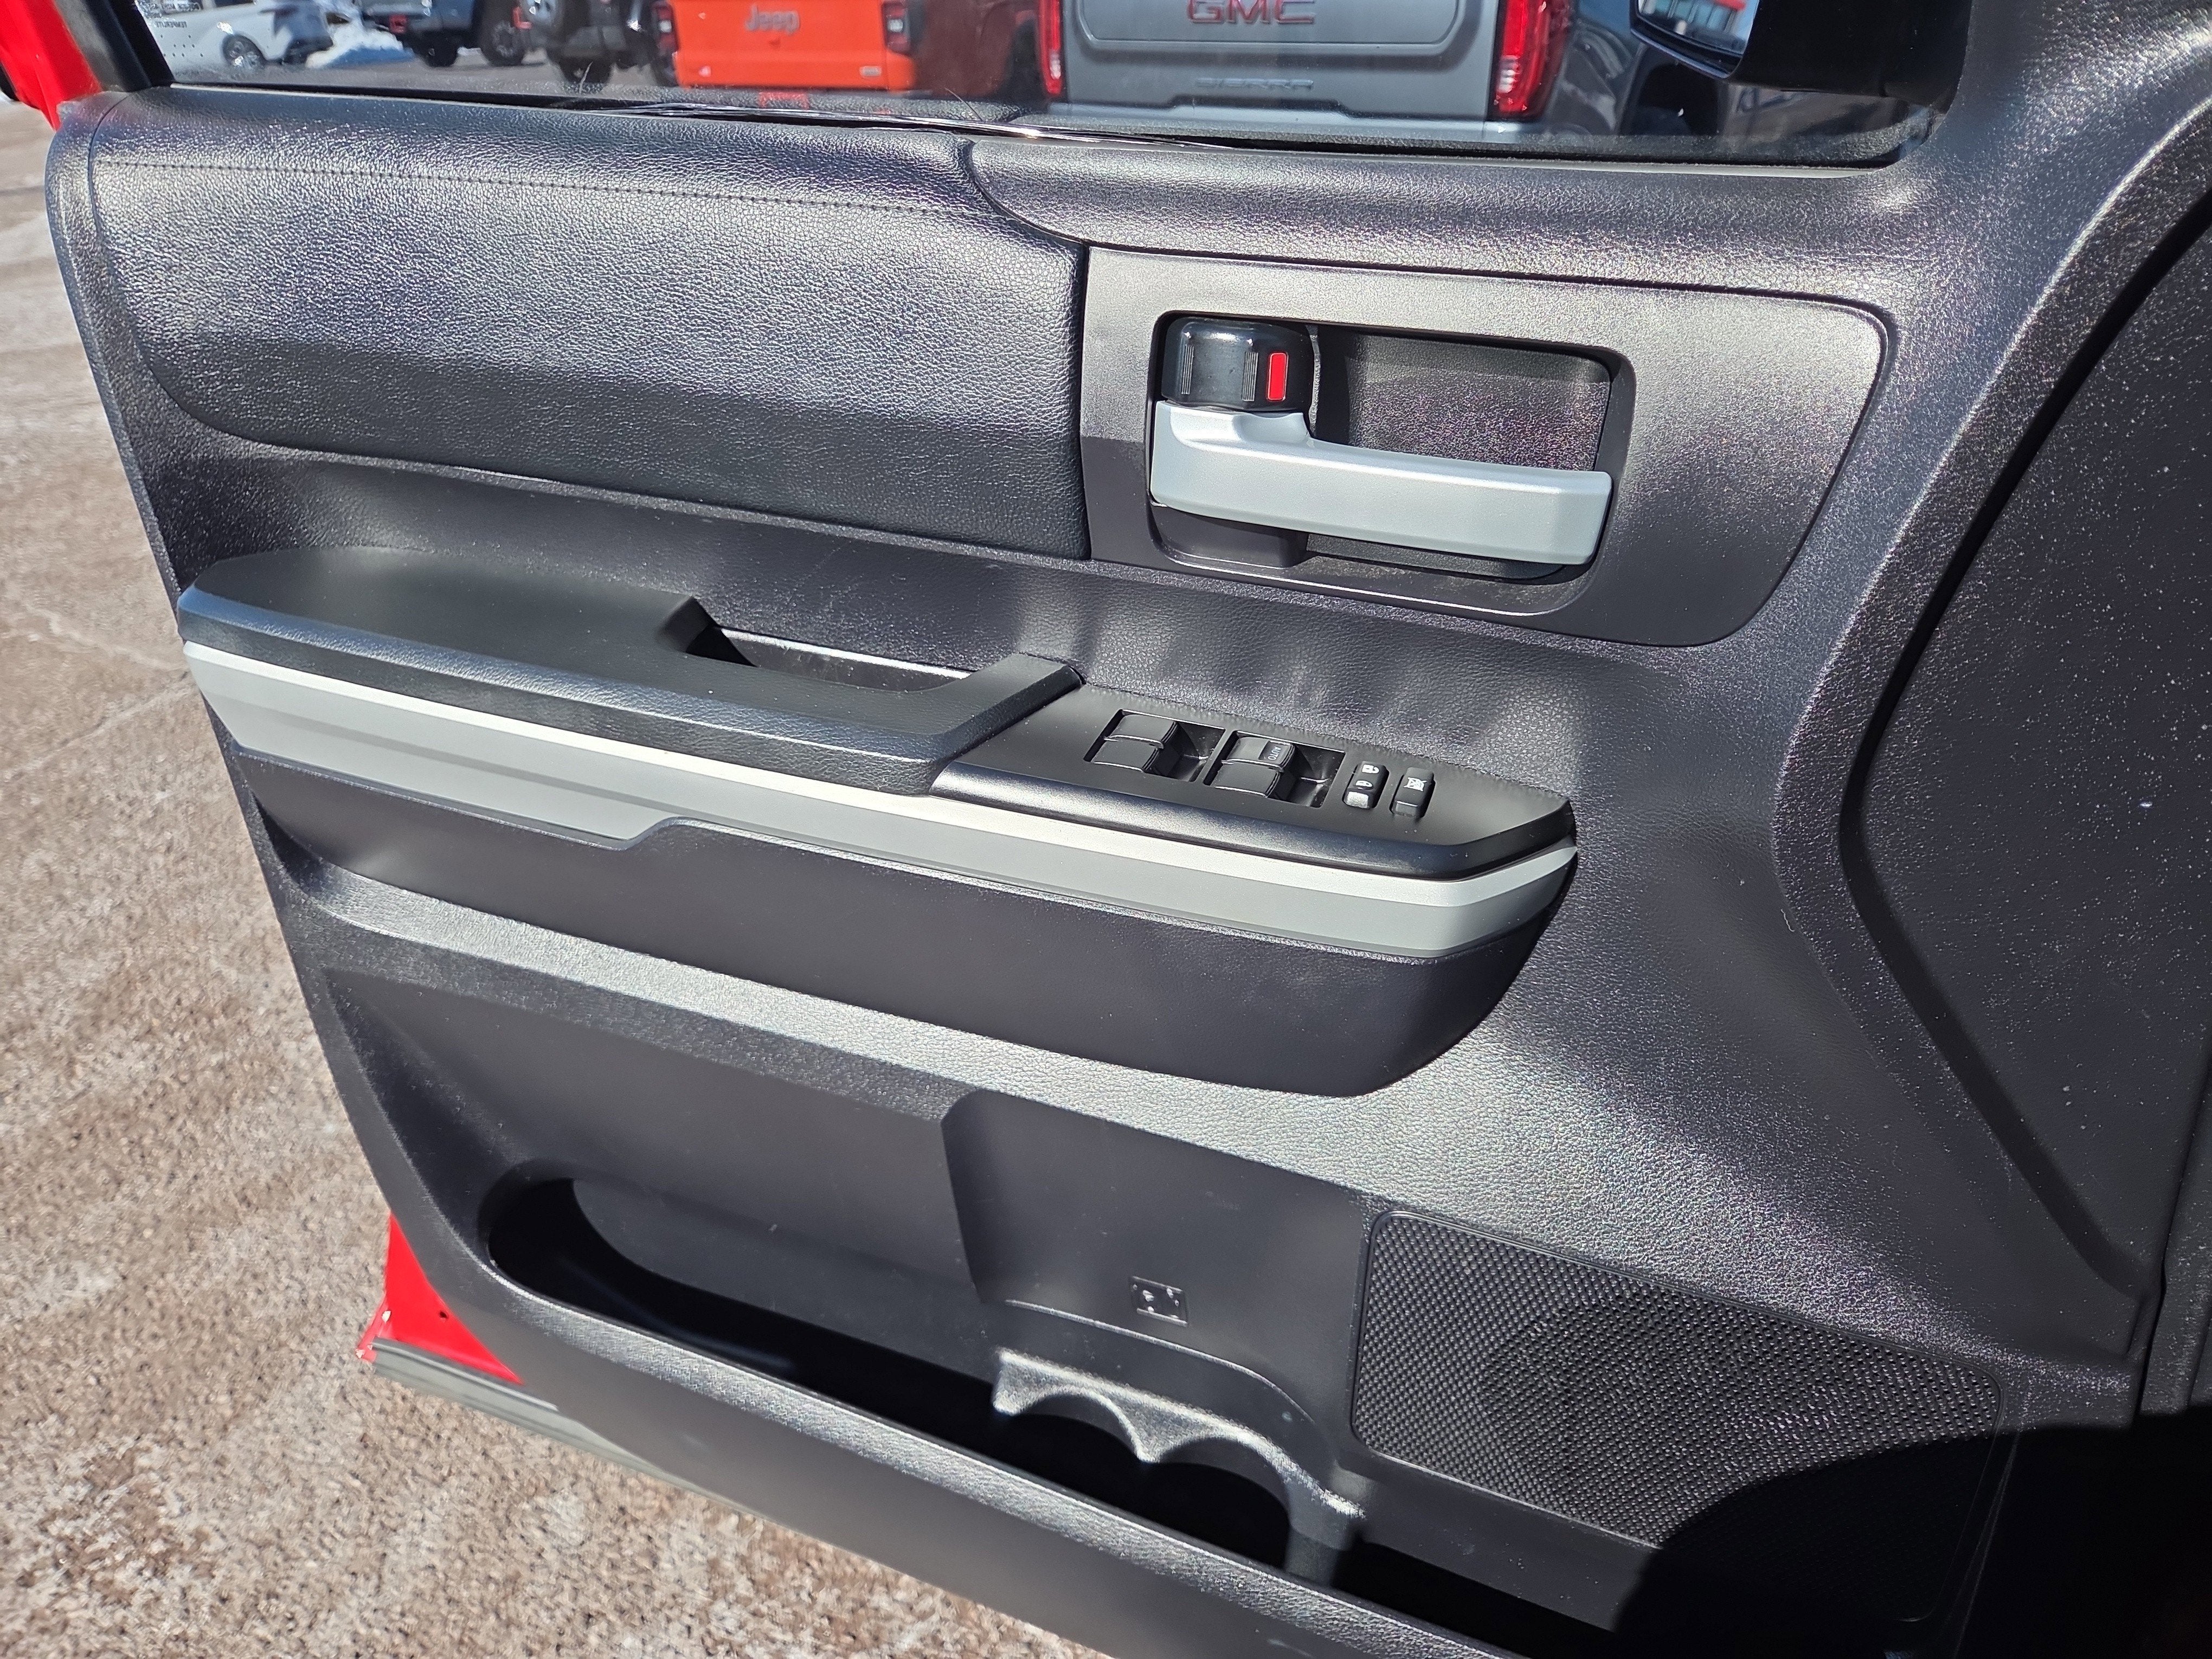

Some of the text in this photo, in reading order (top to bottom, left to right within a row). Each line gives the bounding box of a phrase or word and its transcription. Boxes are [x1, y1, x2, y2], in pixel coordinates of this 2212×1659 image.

[744, 4, 800, 35] Jeep
[1187, 0, 1315, 24] GMC
[1268, 746, 1282, 760] AUTO
